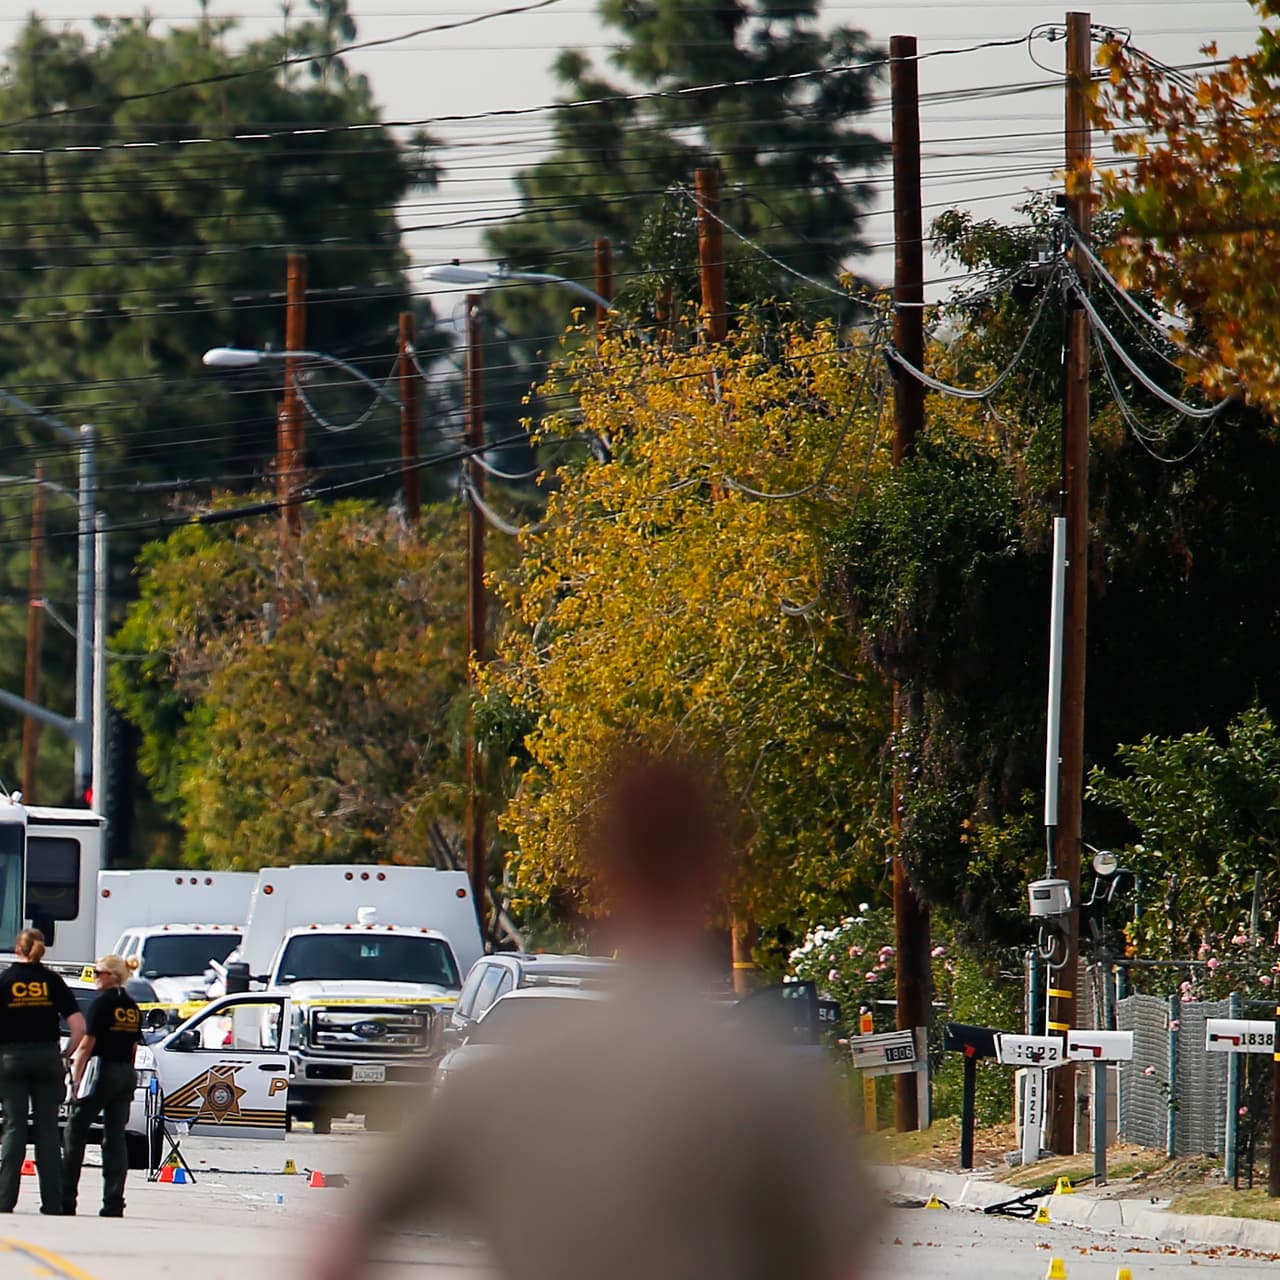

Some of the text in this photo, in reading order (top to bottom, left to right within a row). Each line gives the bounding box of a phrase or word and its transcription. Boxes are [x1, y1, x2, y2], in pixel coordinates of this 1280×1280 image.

[12, 982, 48, 997] CSI
[114, 1007, 140, 1023] CSI
[1241, 1033, 1274, 1046] 1838
[886, 1046, 913, 1061] 1806
[1029, 1073, 1037, 1124] 1822
